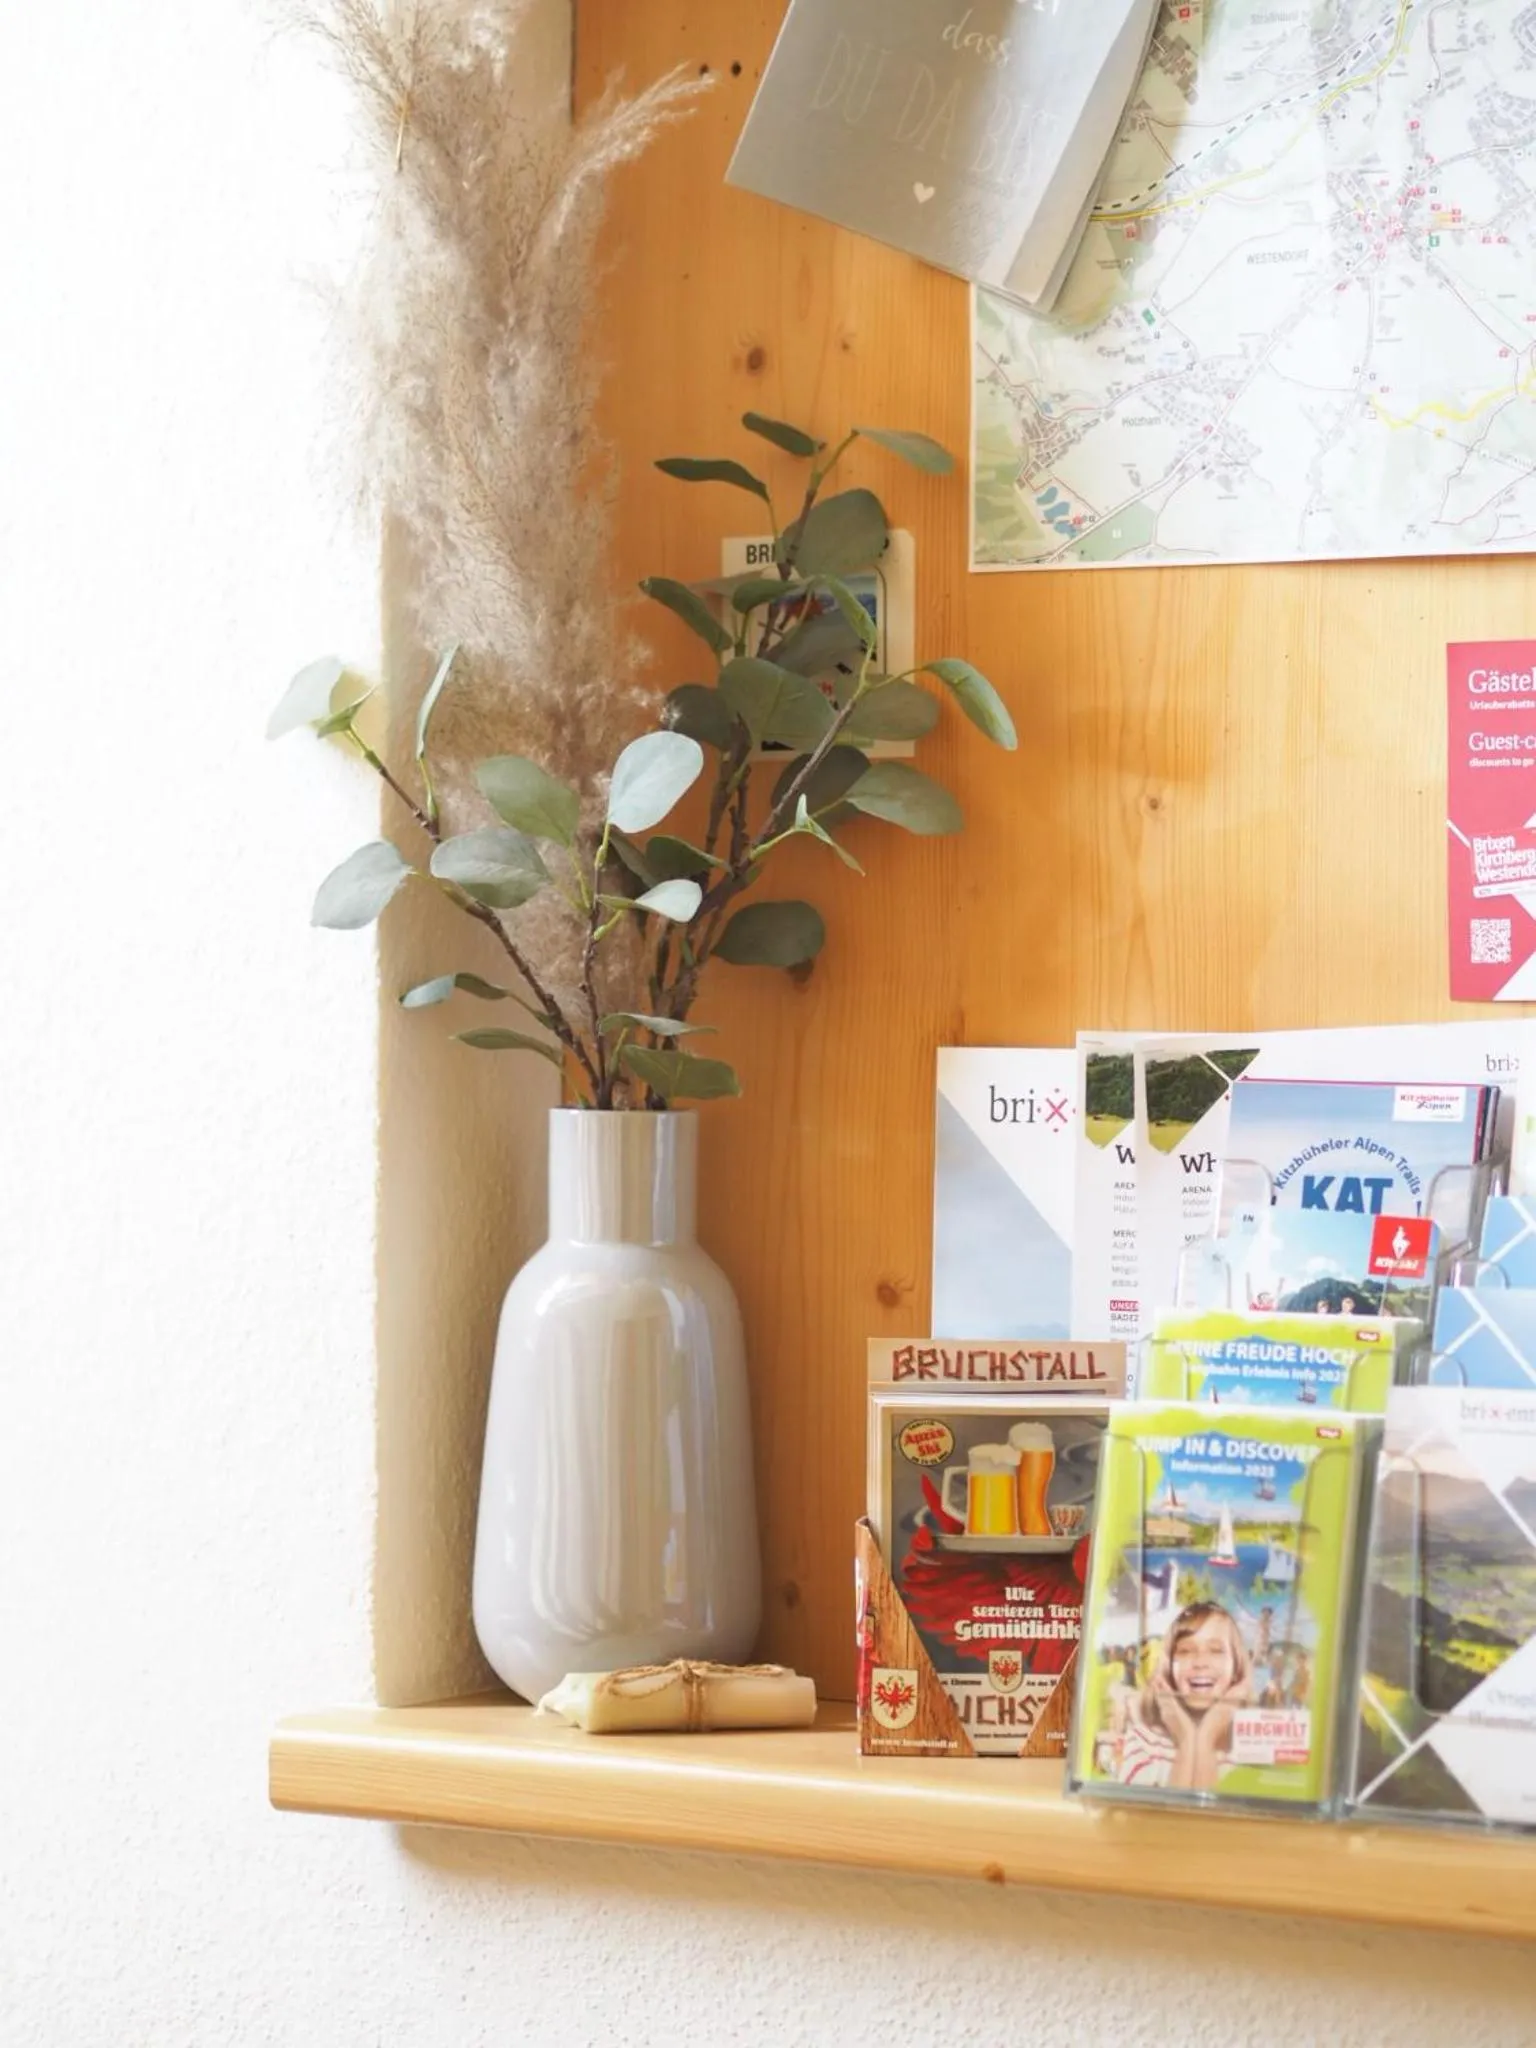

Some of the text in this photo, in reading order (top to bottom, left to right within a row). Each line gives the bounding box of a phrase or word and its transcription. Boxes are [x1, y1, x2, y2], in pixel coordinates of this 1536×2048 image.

[942, 8, 1011, 68] dass
[810, 30, 893, 124] DU
[892, 64, 964, 162] DA
[1467, 732, 1536, 751] Guest-c
[1274, 1136, 1422, 1195] Kitzbüheler Alpen Trails
[1302, 1175, 1394, 1215] KAT
[1226, 1343, 1297, 1362] FREUDE
[892, 1345, 1107, 1381] BRUCHSTALL
[1243, 1365, 1291, 1379] Erlebnis
[1292, 1367, 1317, 1381] Info
[1185, 1438, 1206, 1455] IN
[1208, 1439, 1223, 1457] &
[1171, 1460, 1243, 1475] Information
[1004, 1586, 1036, 1601] Wir
[972, 1604, 1044, 1618] servieren
[1237, 1722, 1307, 1737] BERGWELT
